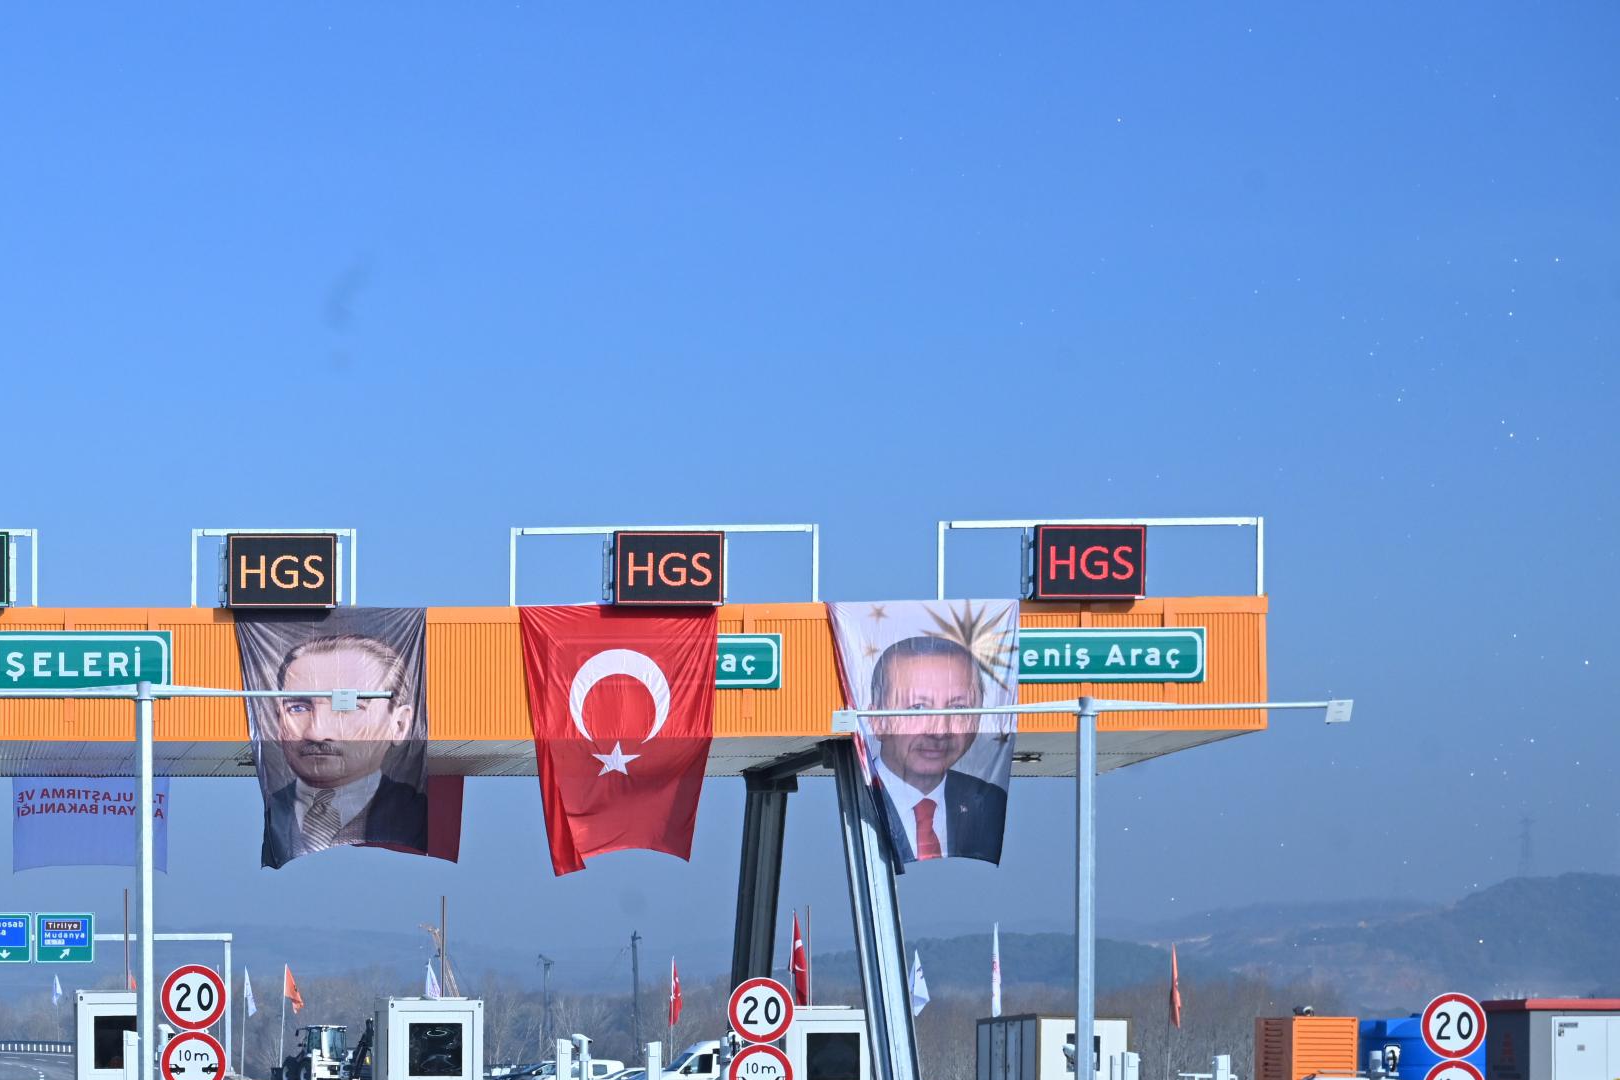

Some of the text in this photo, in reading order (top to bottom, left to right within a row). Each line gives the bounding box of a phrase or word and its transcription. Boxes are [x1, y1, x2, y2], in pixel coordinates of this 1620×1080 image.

[240, 555, 325, 589] HGS
[628, 552, 713, 587] HGS
[1049, 545, 1135, 580] HGS
[1022, 642, 1181, 670] eniş Araç
[44, 932, 86, 940] Mudanya
[175, 982, 214, 1012] 20
[742, 996, 781, 1025] 20
[1436, 1011, 1474, 1041] 20
